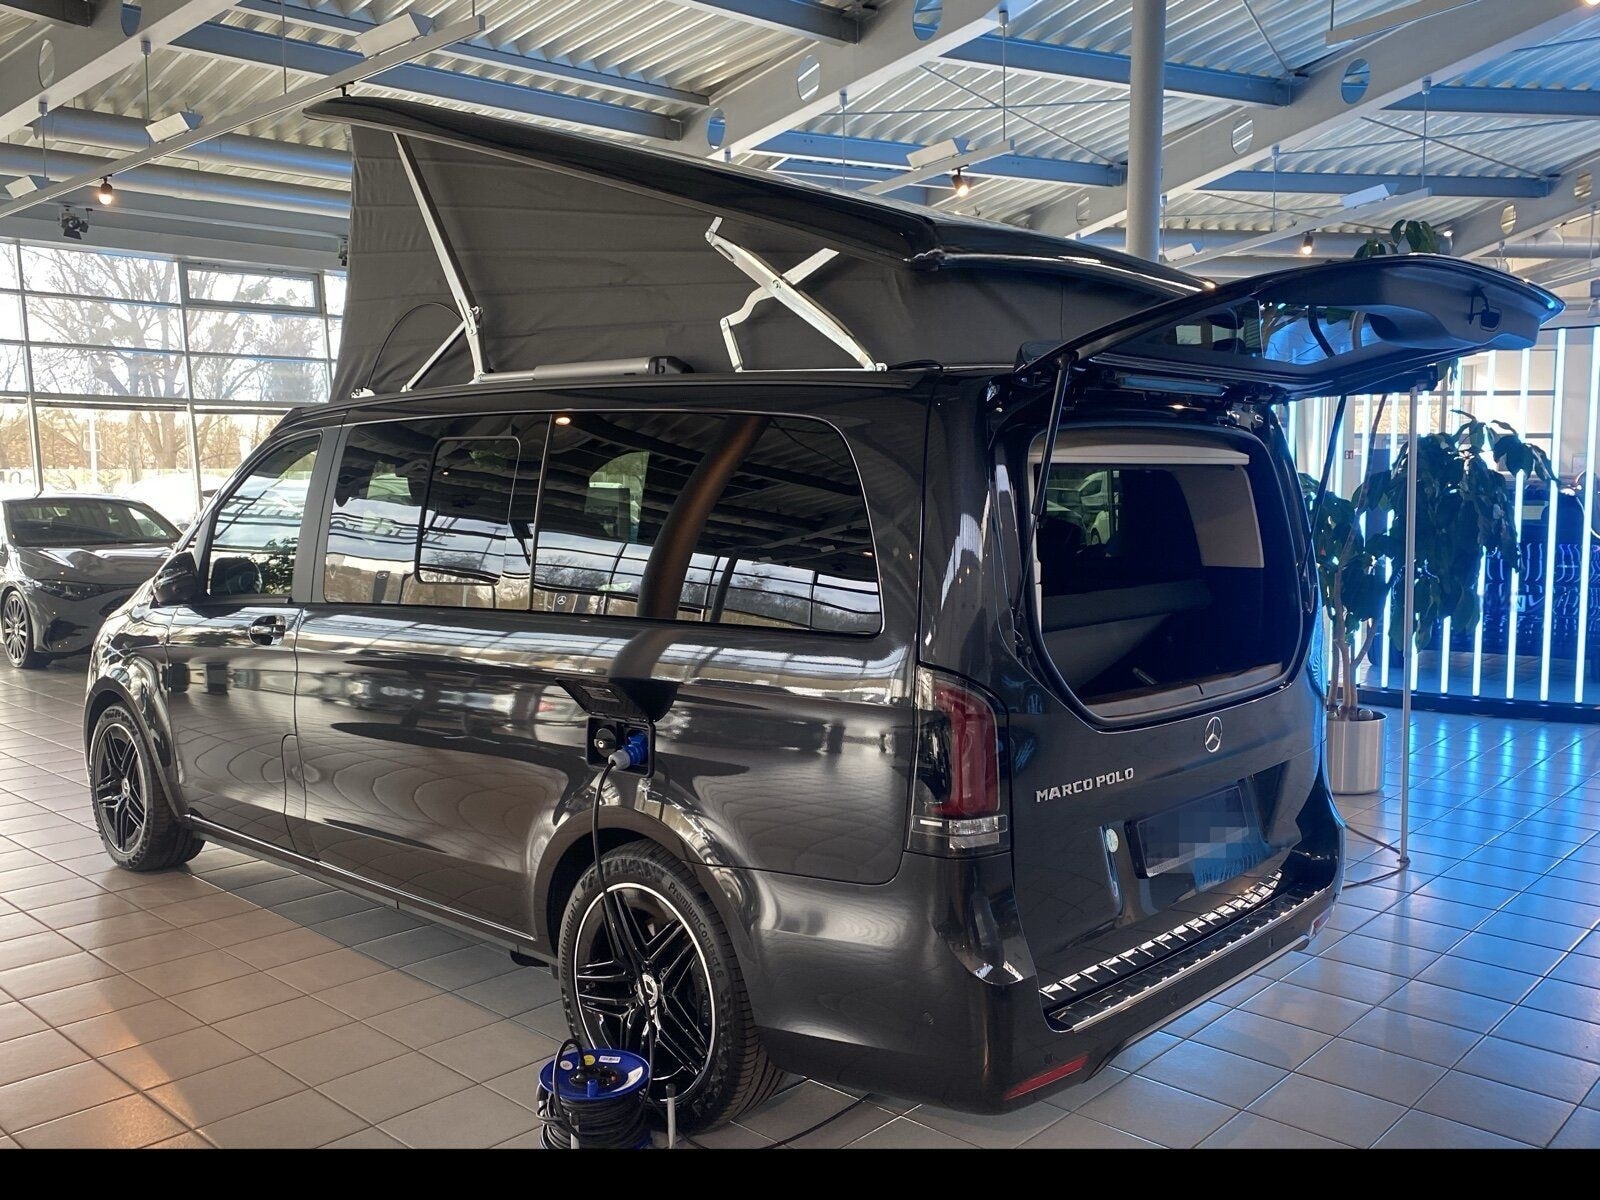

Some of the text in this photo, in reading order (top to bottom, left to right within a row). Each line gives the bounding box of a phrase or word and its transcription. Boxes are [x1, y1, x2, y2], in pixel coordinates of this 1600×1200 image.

[1036, 767, 1134, 802] MARCO POLO
[561, 905, 577, 981] Continental
[668, 881, 721, 967] PremiumContact
